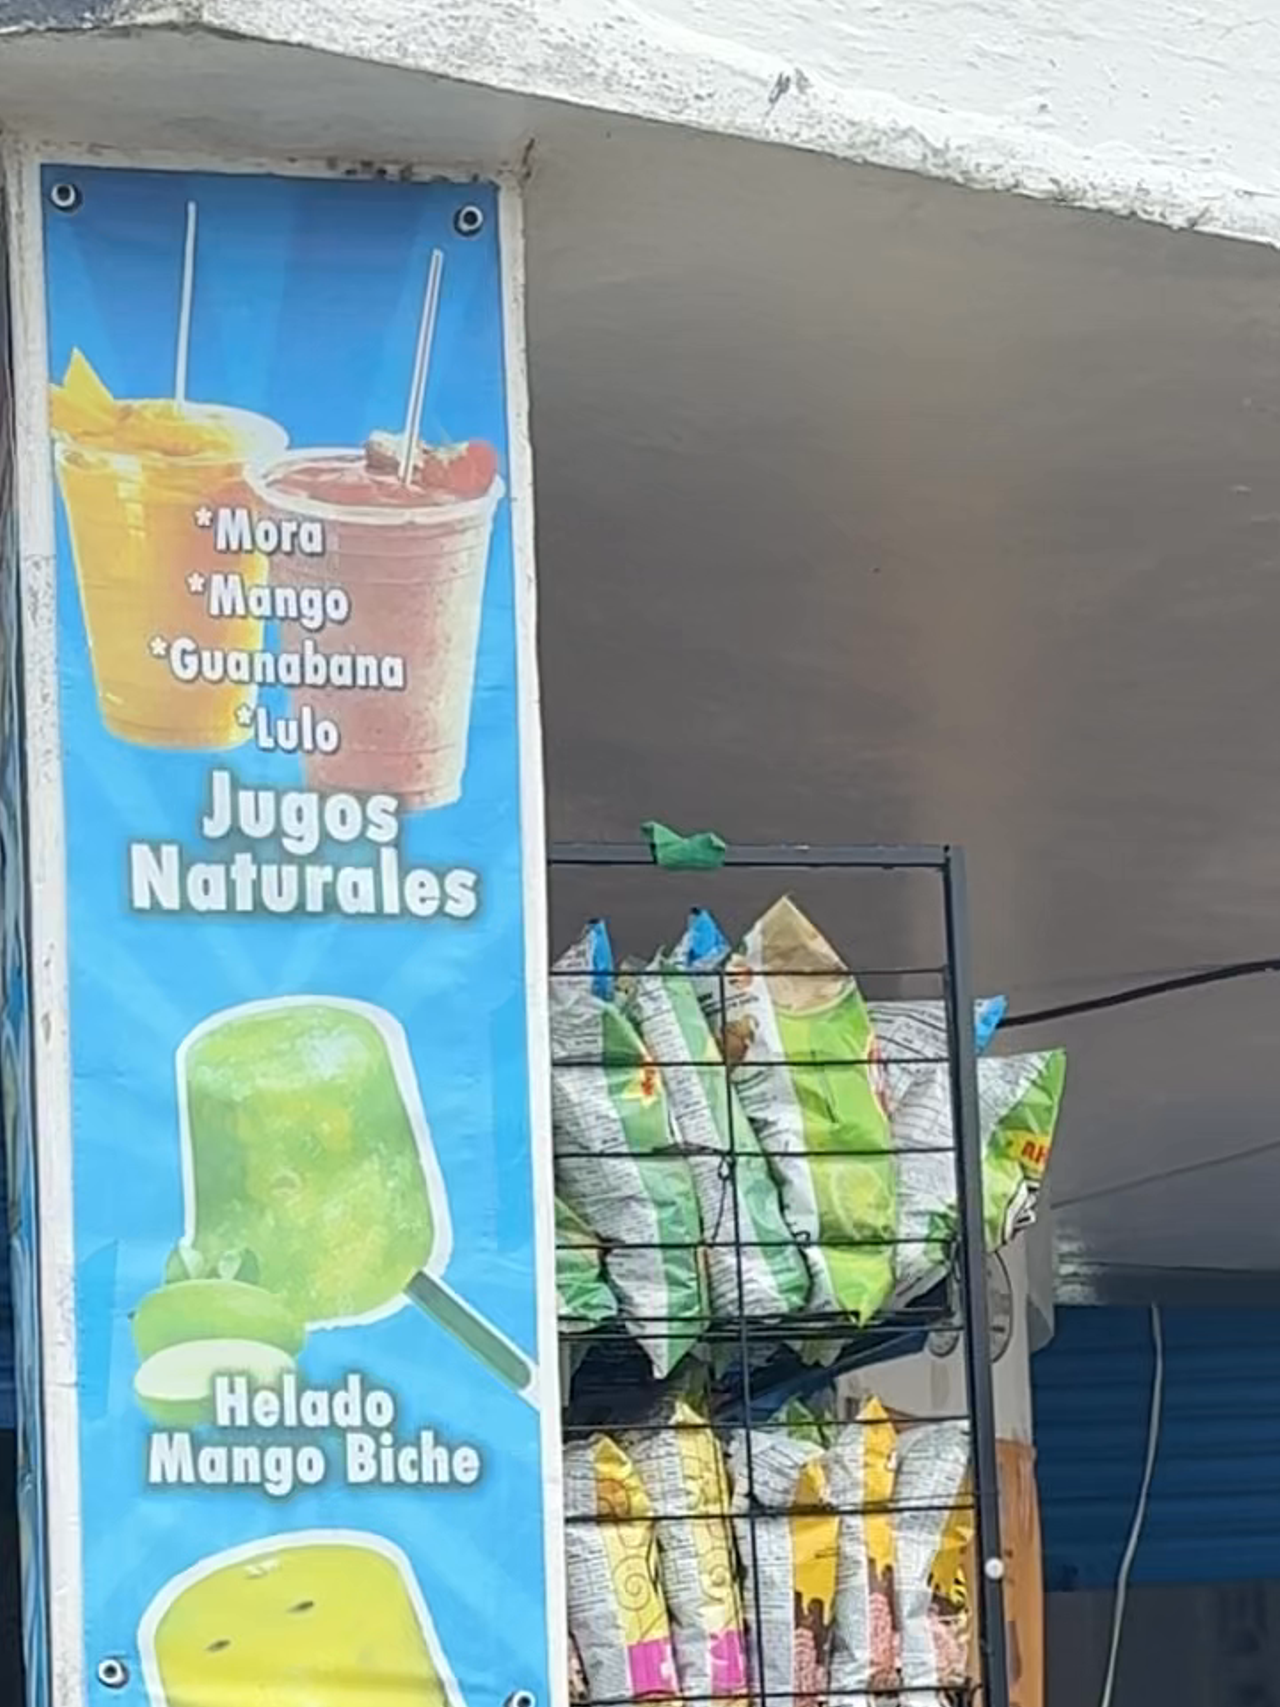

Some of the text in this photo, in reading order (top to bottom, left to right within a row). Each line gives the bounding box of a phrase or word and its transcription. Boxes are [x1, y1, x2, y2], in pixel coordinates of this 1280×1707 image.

[202, 771, 400, 855] Jugos
[130, 843, 479, 919] Naturales
[214, 1374, 396, 1428] Helado
[147, 1431, 482, 1497] Mango Biche
